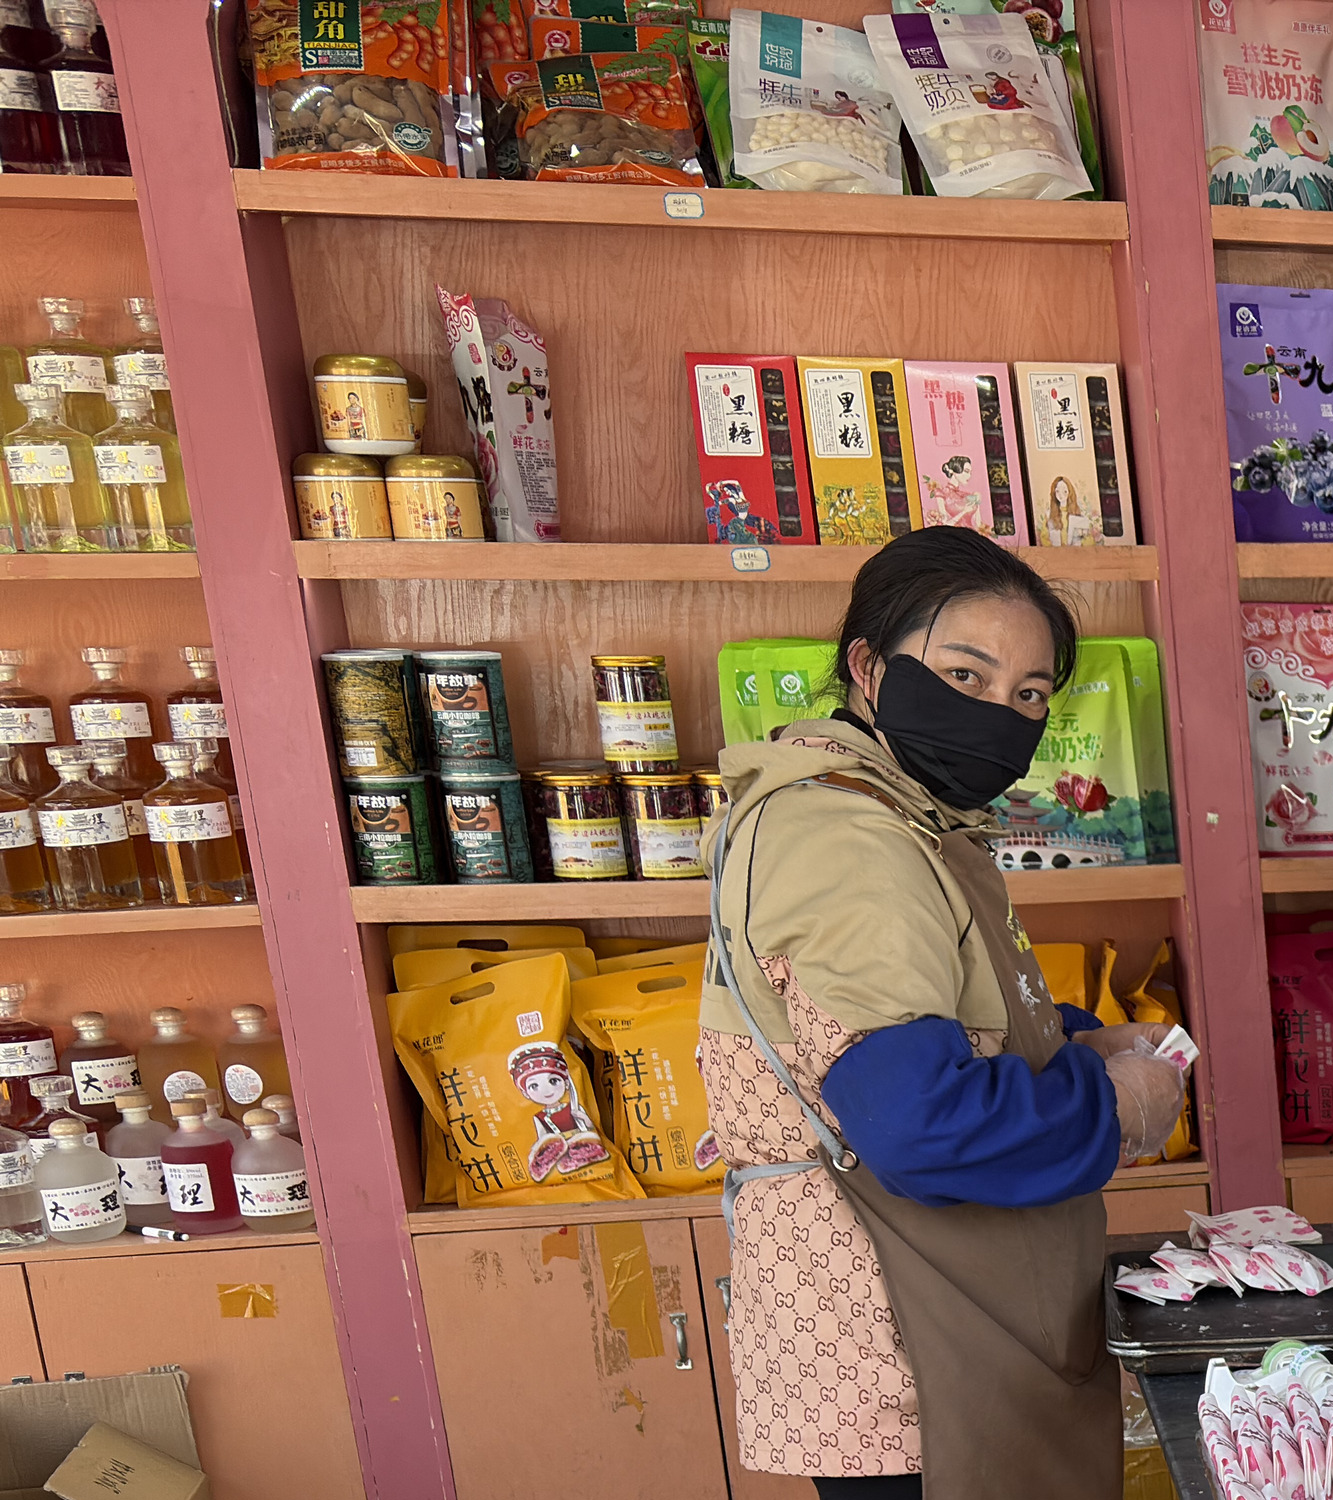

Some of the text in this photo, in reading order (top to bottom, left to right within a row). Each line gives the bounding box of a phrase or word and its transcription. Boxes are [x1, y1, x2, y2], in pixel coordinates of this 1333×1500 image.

[1240, 42, 1302, 71] 益生元
[915, 72, 959, 93] 牦牛
[1222, 64, 1324, 105] 雪桃奶冻
[923, 87, 968, 112] 奶贝
[1276, 345, 1307, 360] 云南
[725, 394, 756, 446] 黑糖
[836, 391, 865, 449] 黑糖
[1053, 396, 1079, 442] 黑糖
[1293, 692, 1326, 703] 云南
[1277, 1008, 1312, 1124] 鲜花饼
[179, 1183, 203, 1207] 理
